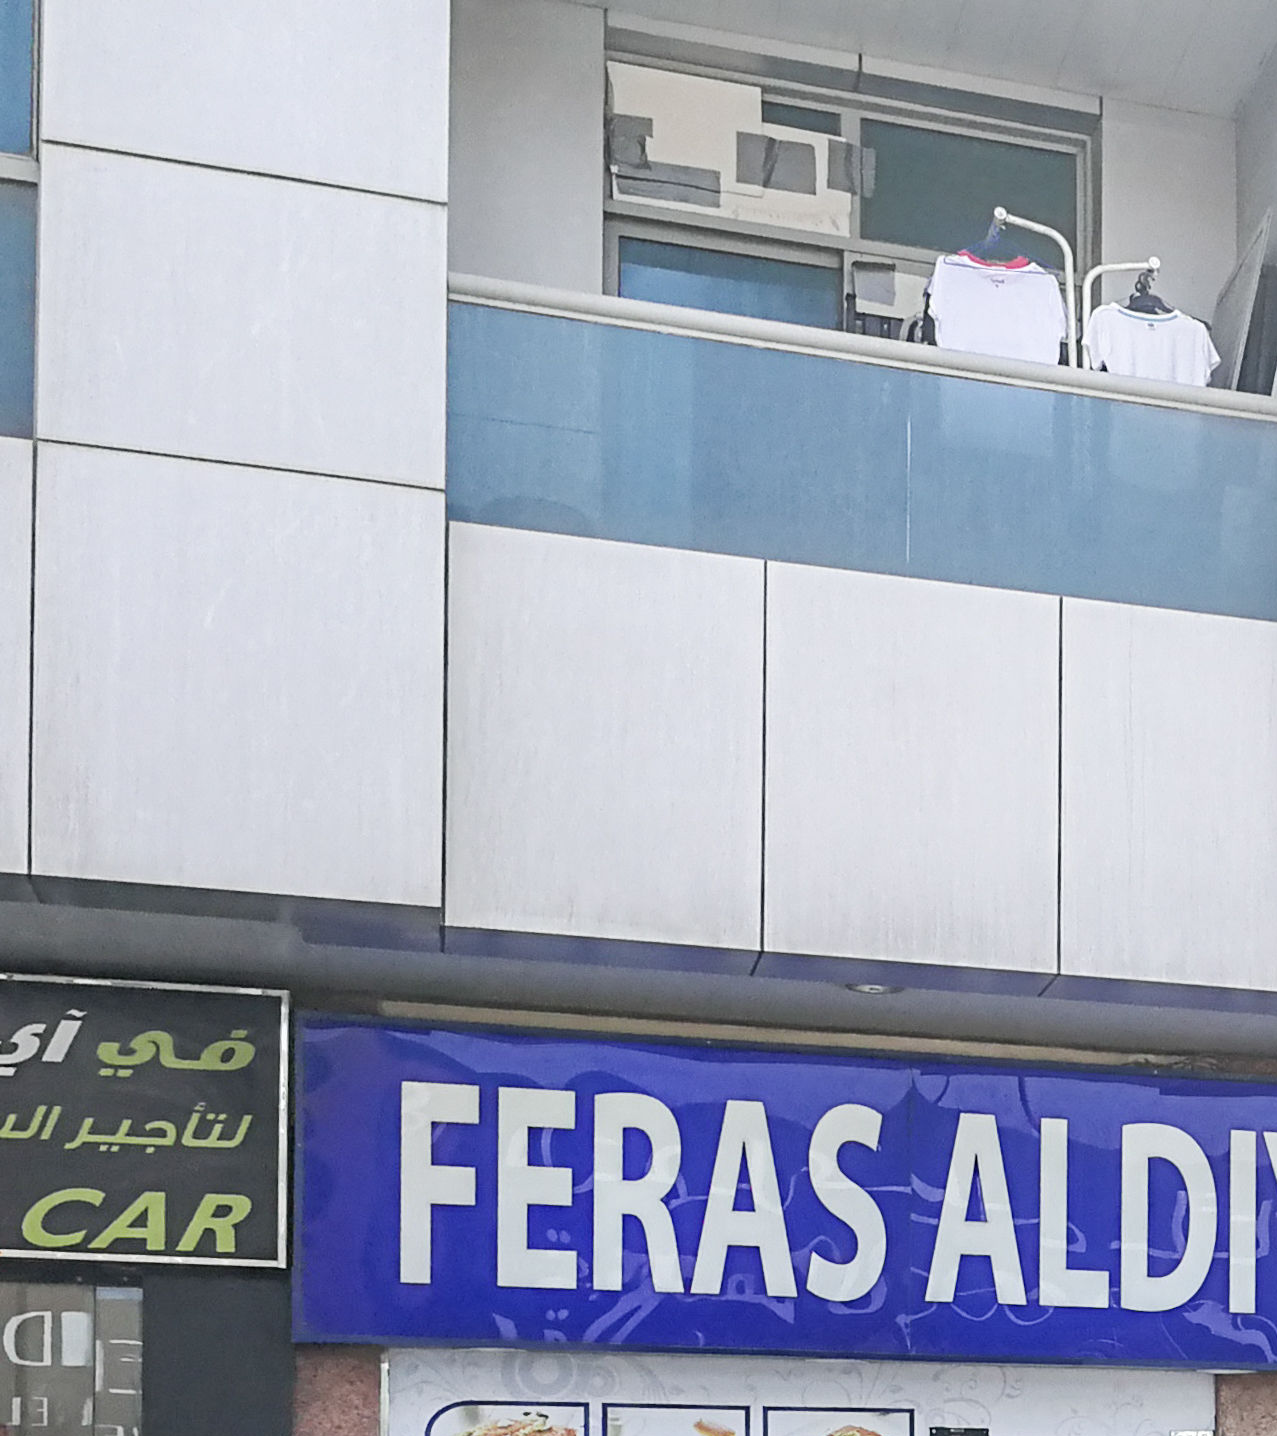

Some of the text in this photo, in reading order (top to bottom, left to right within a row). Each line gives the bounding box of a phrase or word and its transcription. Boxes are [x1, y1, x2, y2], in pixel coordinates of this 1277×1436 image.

[96, 1029, 256, 1078] في
[64, 1102, 253, 1154] لتأجير
[21, 1187, 252, 1254] CAR
[399, 1080, 888, 1303] FERAS
